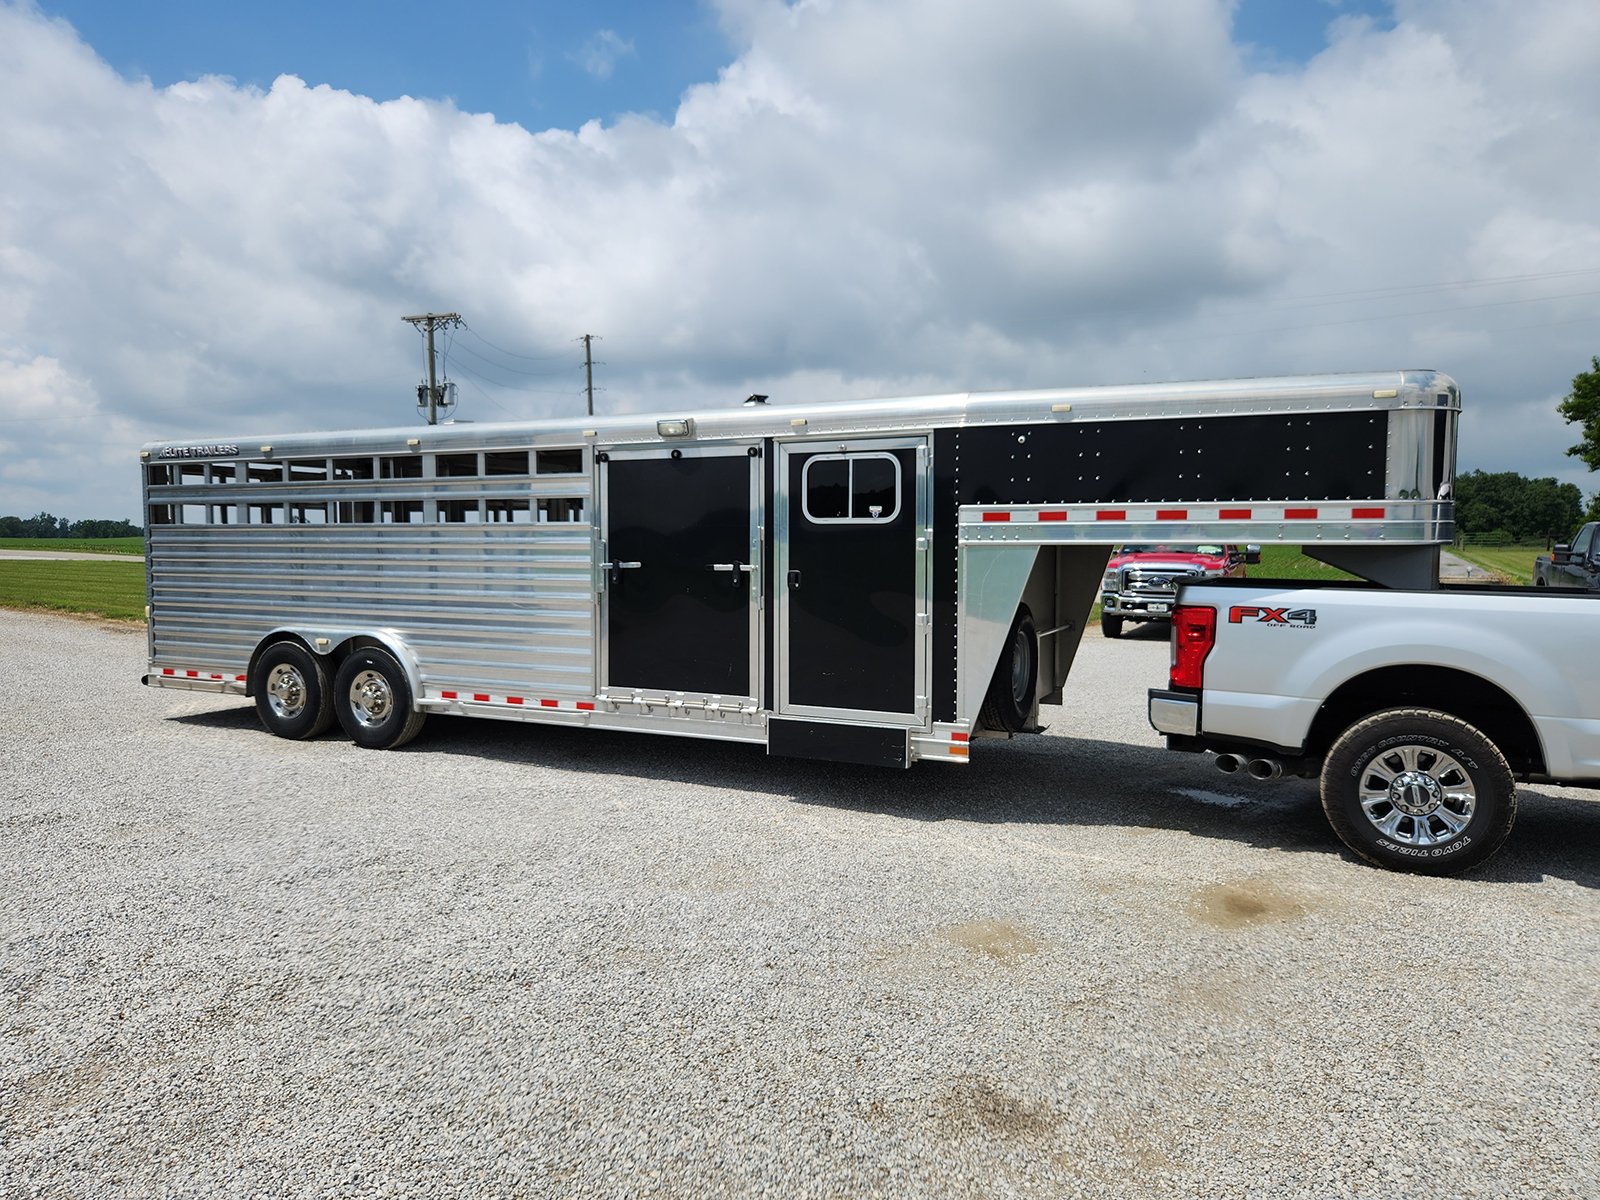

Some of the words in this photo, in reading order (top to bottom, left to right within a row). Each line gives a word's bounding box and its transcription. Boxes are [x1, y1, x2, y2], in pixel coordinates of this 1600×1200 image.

[164, 446, 190, 458] ELITE
[191, 444, 239, 456] TRAILERS
[1228, 605, 1317, 625] FX4
[1351, 745, 1376, 777] OPEN
[1378, 734, 1449, 749] COUNTRY
[1376, 838, 1429, 857] TIRES
[1431, 835, 1472, 857] TOYO
